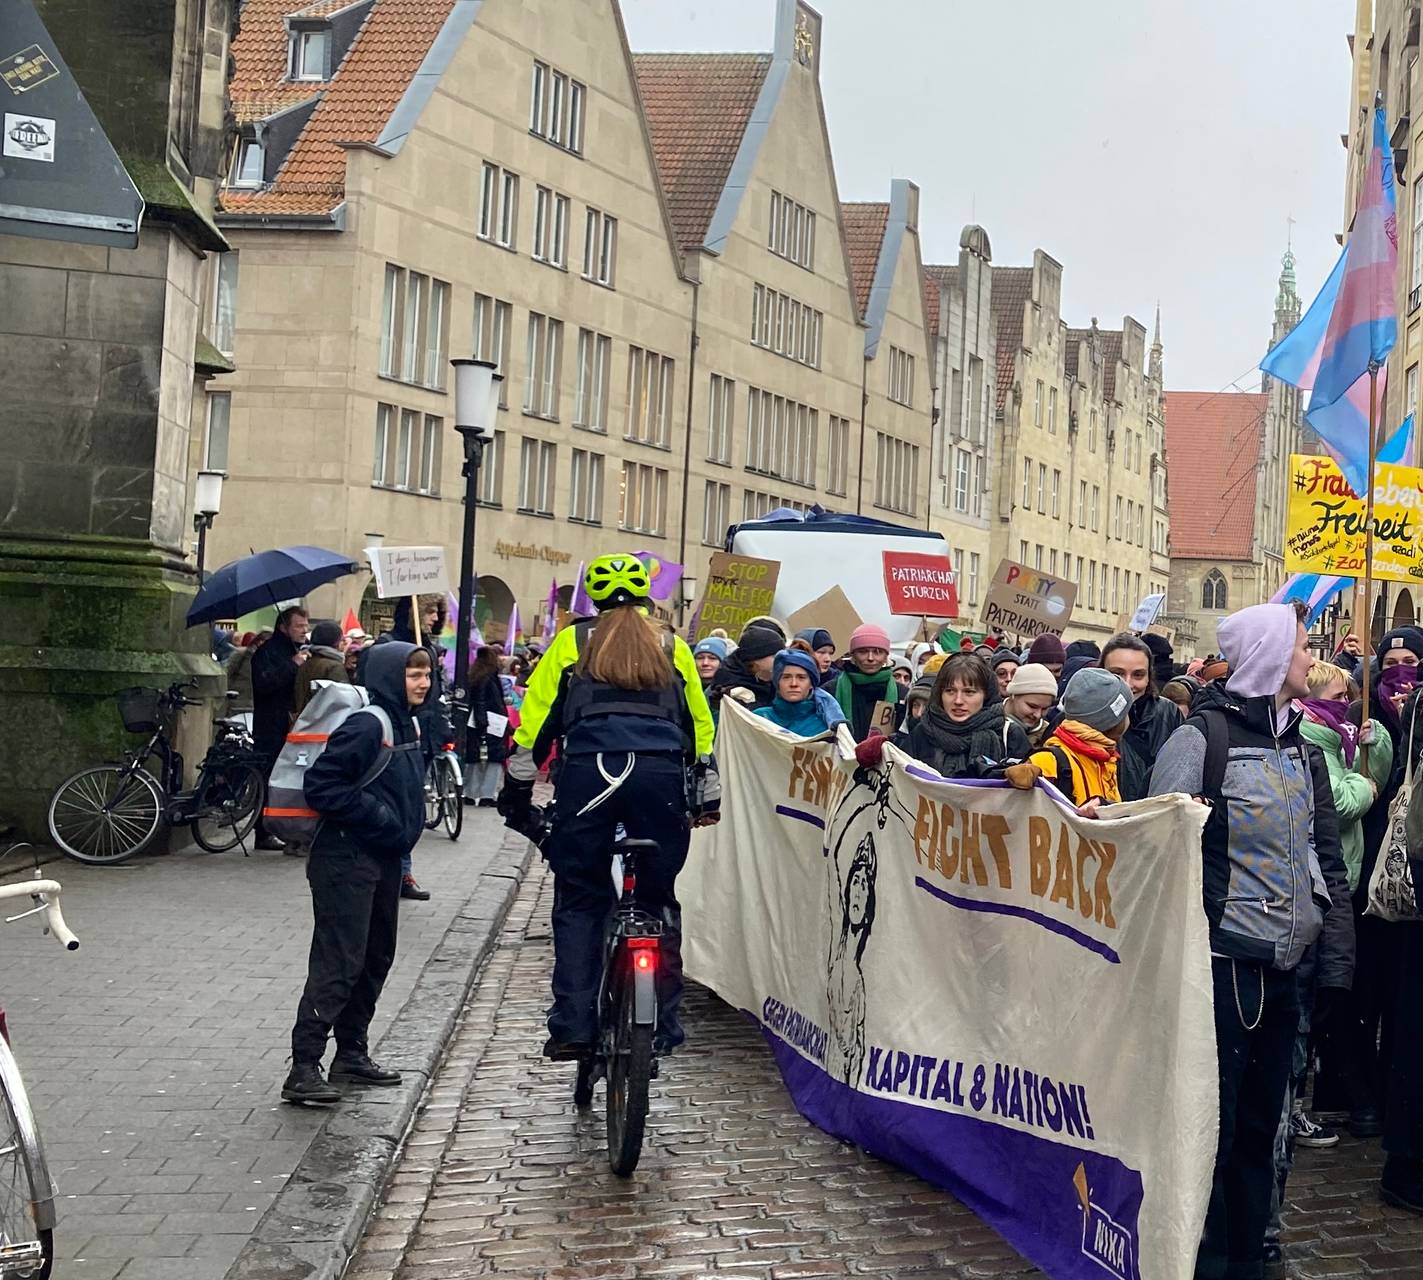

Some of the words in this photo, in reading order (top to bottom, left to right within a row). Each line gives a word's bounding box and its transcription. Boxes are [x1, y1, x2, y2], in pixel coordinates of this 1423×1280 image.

[1294, 459, 1361, 500] #Frau
[726, 562, 769, 581] STOP
[891, 567, 954, 585] PATRIARCHAT
[1006, 566, 1057, 597] PARTY
[706, 582, 750, 603] MALE
[748, 587, 775, 608] EGO
[1014, 594, 1040, 610] STATT
[914, 794, 1012, 889] FIGHT
[1028, 816, 1117, 929] BACK
[866, 1046, 965, 1107] KAPITAL
[969, 1064, 988, 1112] &
[992, 1063, 1096, 1140] NATION!
[1093, 1218, 1126, 1274] NIKA
